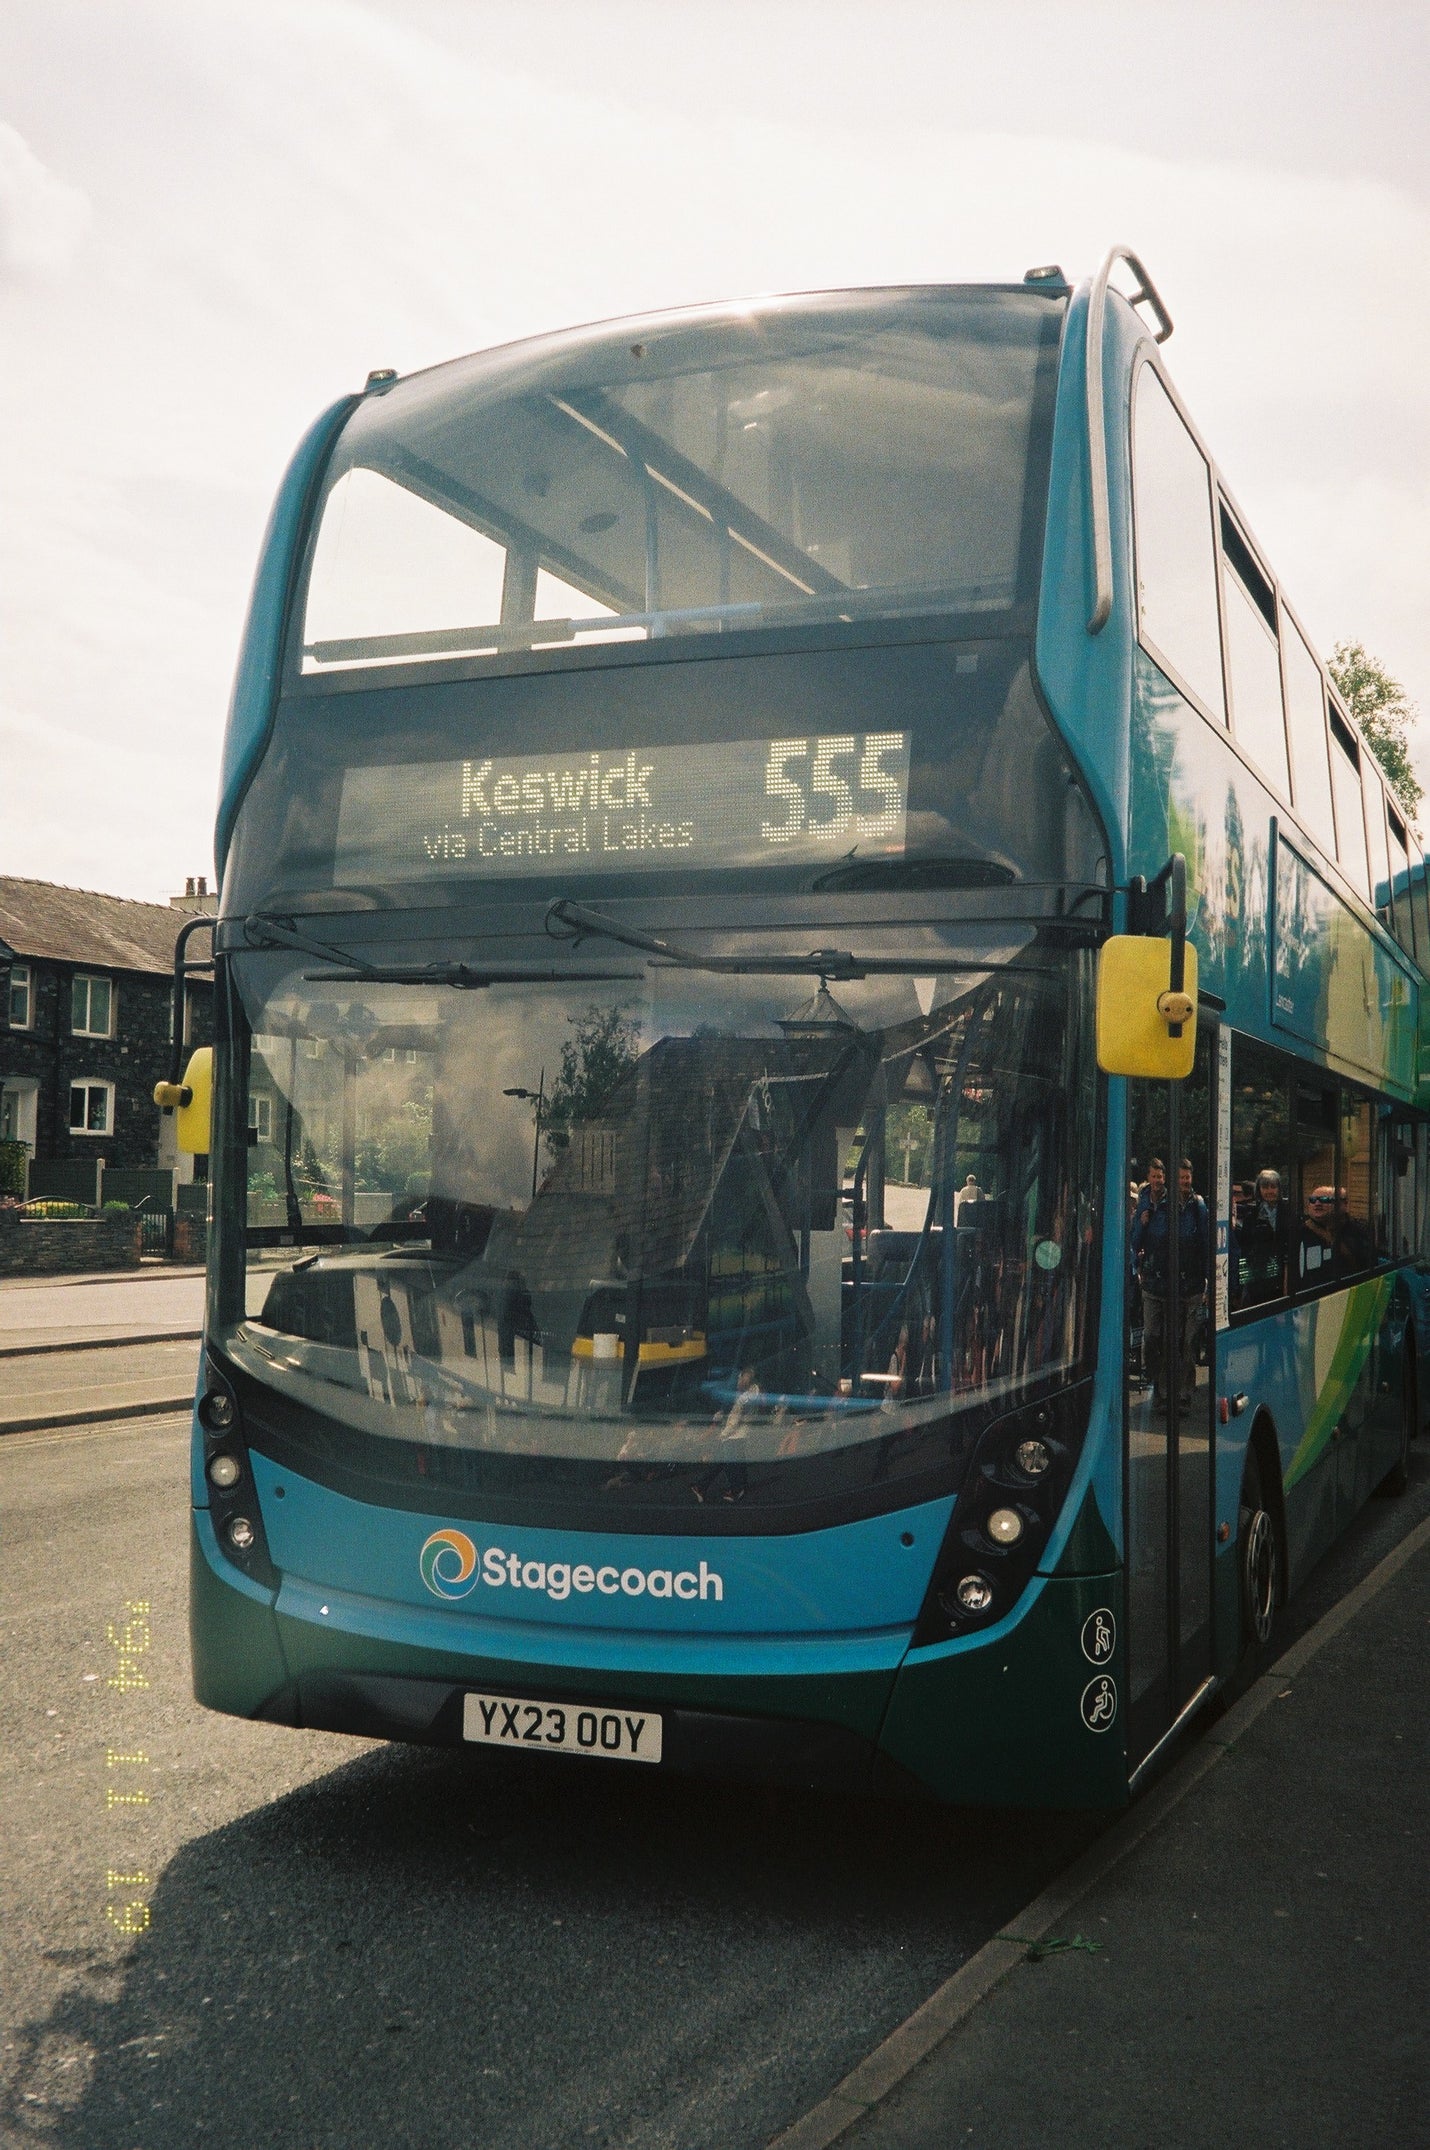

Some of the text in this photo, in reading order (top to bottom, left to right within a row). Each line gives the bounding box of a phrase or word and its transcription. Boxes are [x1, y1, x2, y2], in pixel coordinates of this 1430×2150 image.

[461, 751, 654, 818] Keswick
[761, 734, 904, 841] 555
[424, 815, 694, 858] via Central Lakes
[482, 1548, 723, 1601] Stagecoach
[479, 1701, 645, 1752] YX23 OOY
